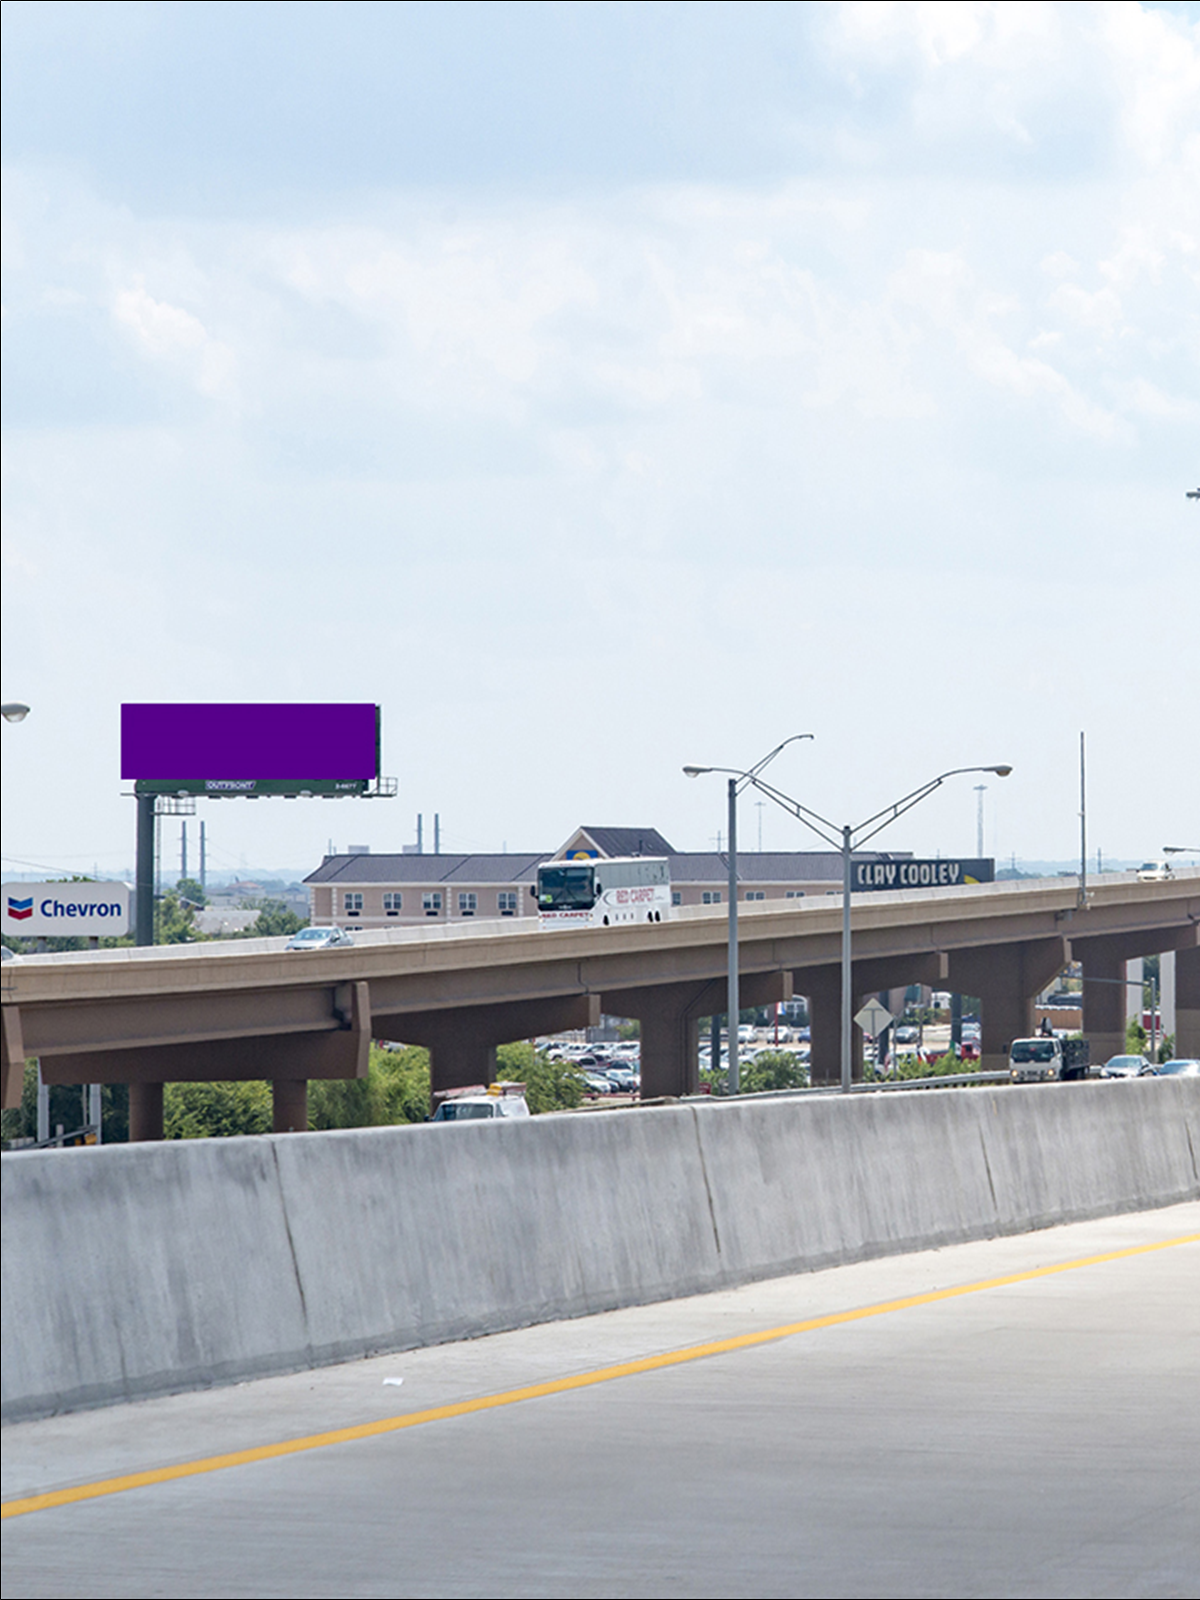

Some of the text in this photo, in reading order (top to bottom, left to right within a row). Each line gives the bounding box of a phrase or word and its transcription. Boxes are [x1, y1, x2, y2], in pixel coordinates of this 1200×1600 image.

[857, 863, 959, 884] CLAY COOLEY
[616, 888, 655, 904] RED CARPET
[40, 899, 122, 918] Chevron
